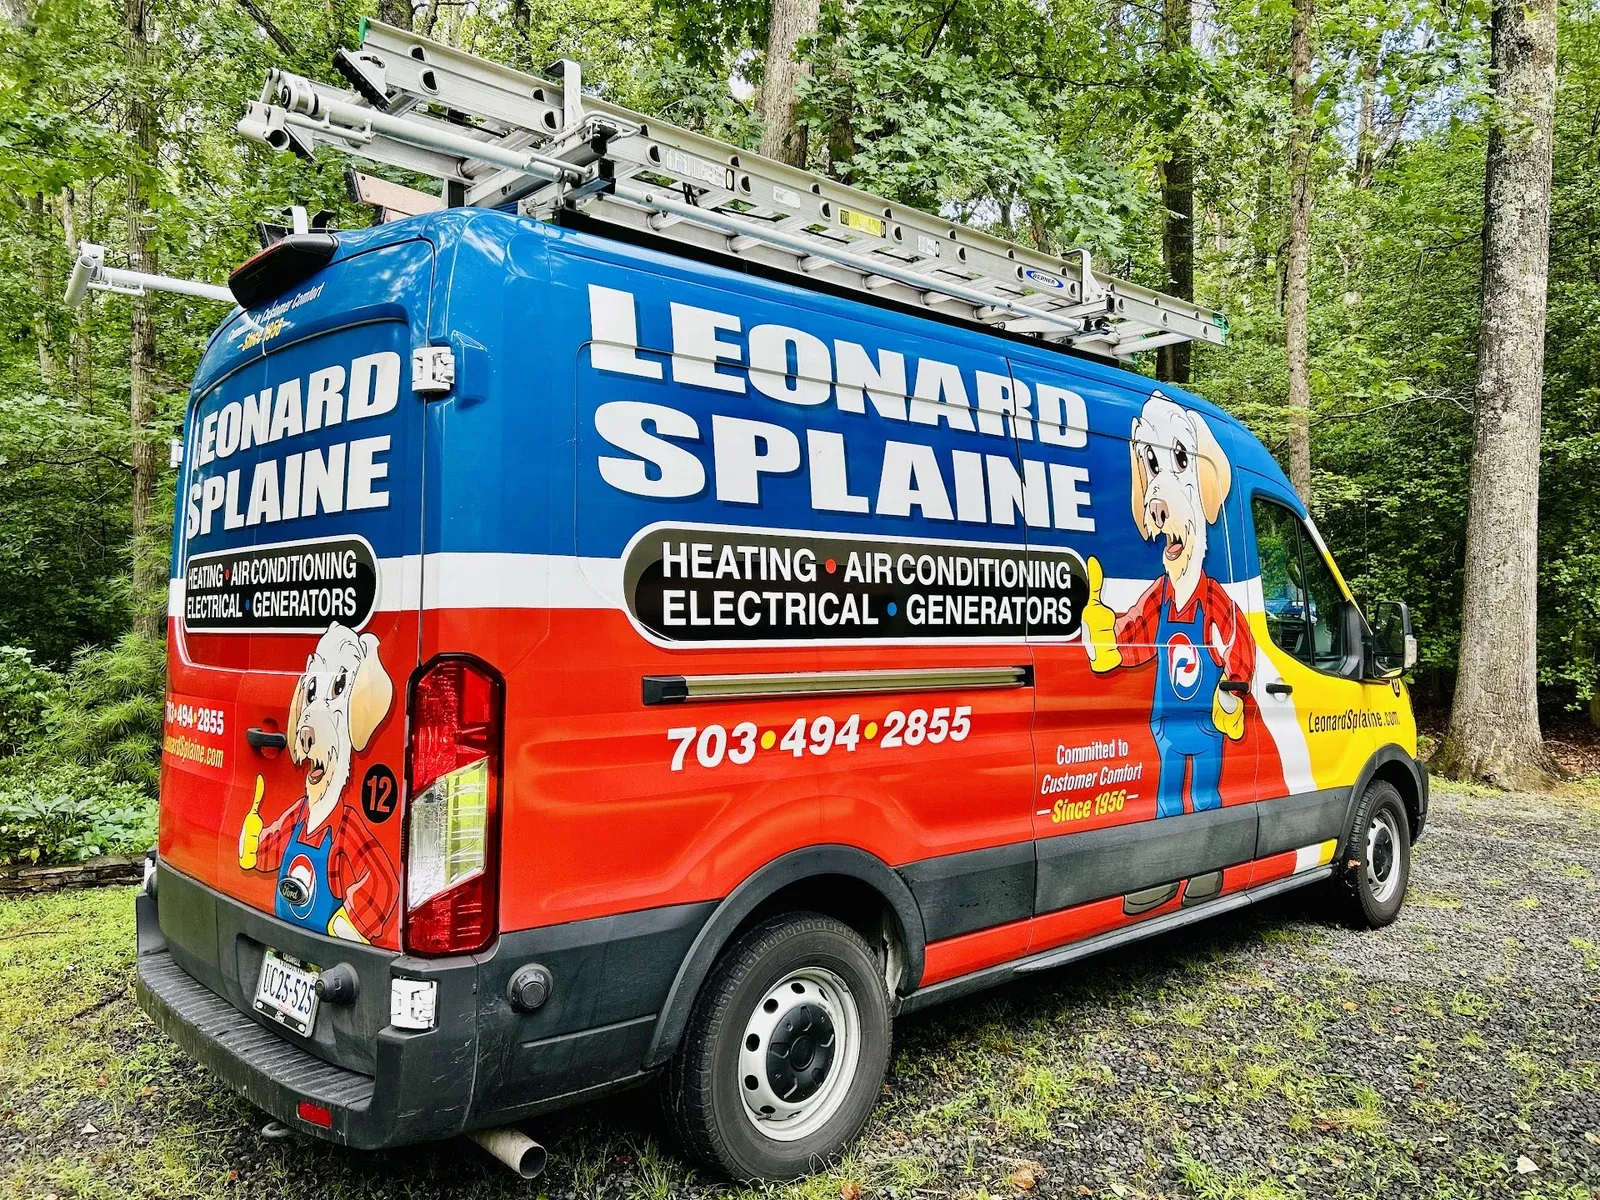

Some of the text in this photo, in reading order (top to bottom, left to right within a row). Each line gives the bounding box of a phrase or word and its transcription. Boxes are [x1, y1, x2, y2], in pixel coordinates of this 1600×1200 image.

[1032, 273, 1056, 285] WERNER
[587, 284, 1089, 448] LEONARD
[193, 352, 400, 471] LEONARD
[594, 401, 1096, 532] SPLAINE
[187, 435, 391, 540] SPLAINE
[188, 550, 357, 590] HEATING AIR CONDITIONING
[663, 542, 1072, 589] HEATING AIR CONDITIONING
[187, 587, 357, 618] ELECTRICAL GENERATORS
[663, 590, 1072, 626] ELECTRICAL GENERATORS
[1056, 739, 1128, 765] Committed to
[367, 775, 392, 813] 12
[1041, 762, 1143, 794] Customer Comfort
[1052, 789, 1127, 823] Since 1956
[263, 963, 315, 1015] UC25-525
